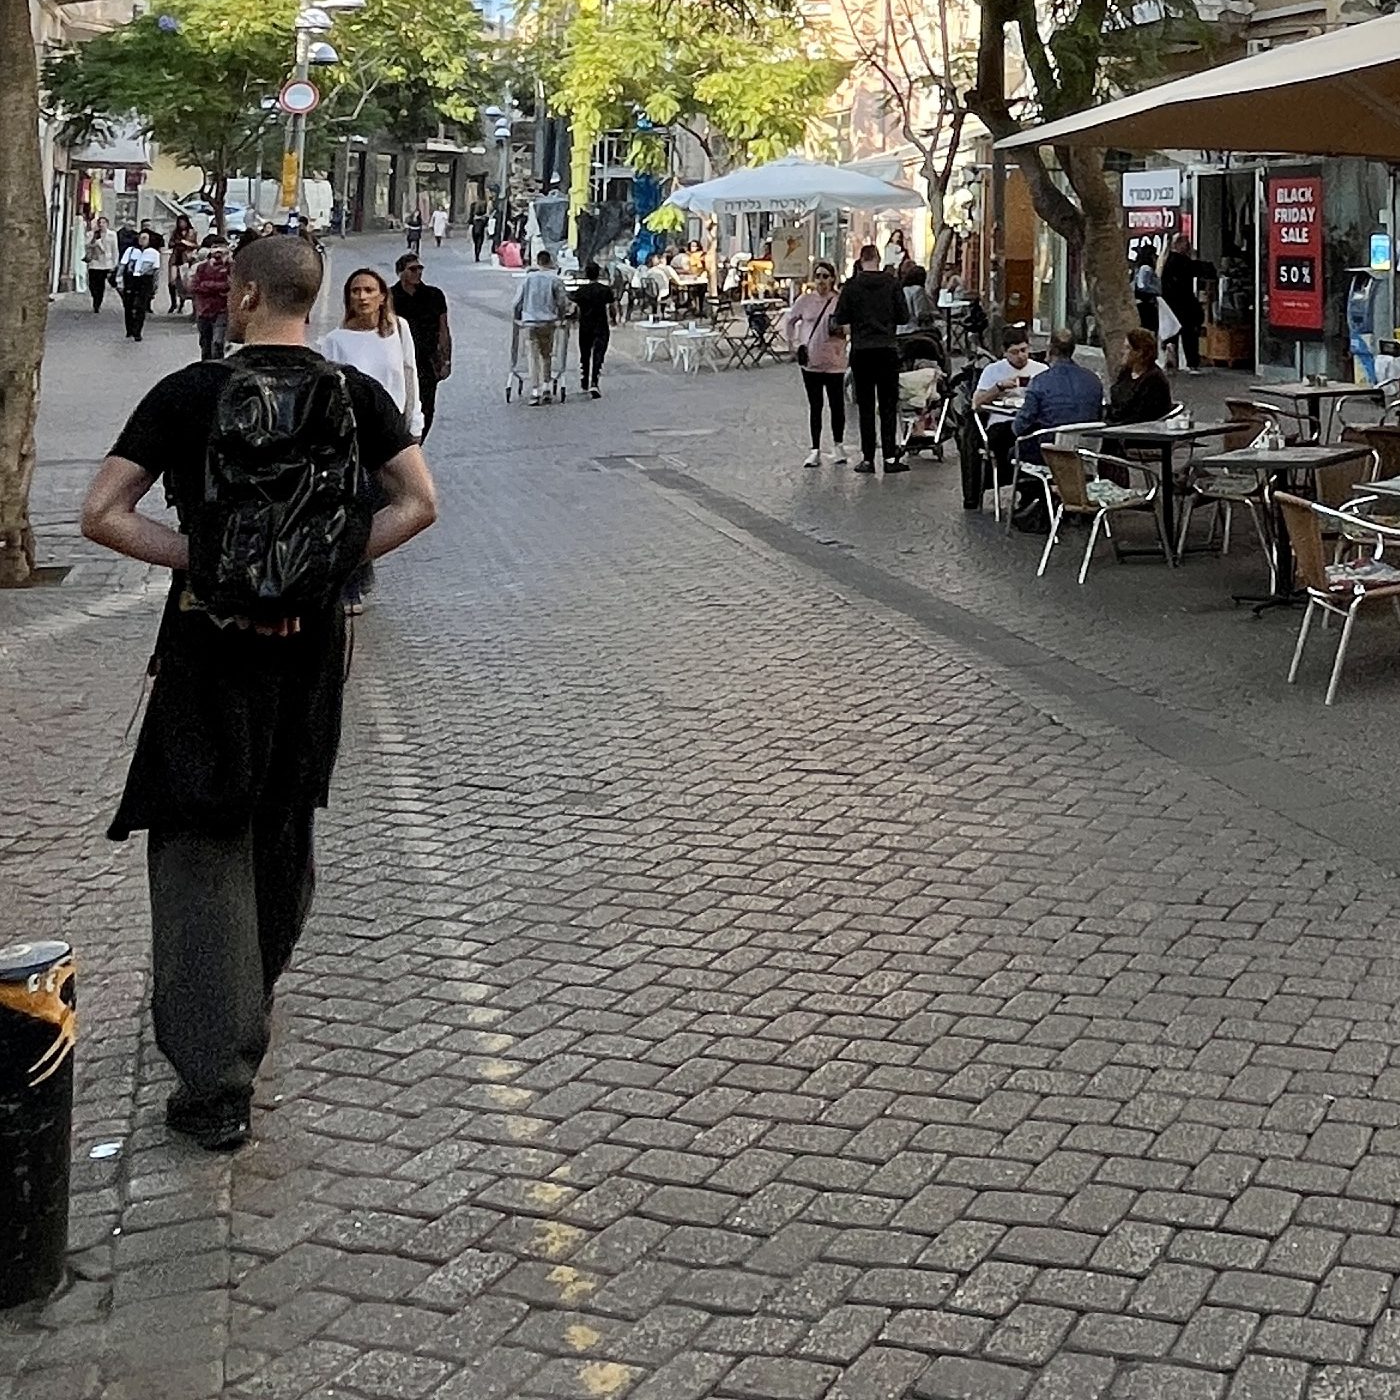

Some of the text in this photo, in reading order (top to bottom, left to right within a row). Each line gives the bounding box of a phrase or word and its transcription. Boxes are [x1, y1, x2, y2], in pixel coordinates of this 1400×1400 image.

[1277, 187, 1313, 204] BLACK
[724, 198, 762, 211] גלידה
[1274, 207, 1316, 224] FRIDAY
[1280, 227, 1310, 244] SALE
[1280, 265, 1311, 284] 50%
